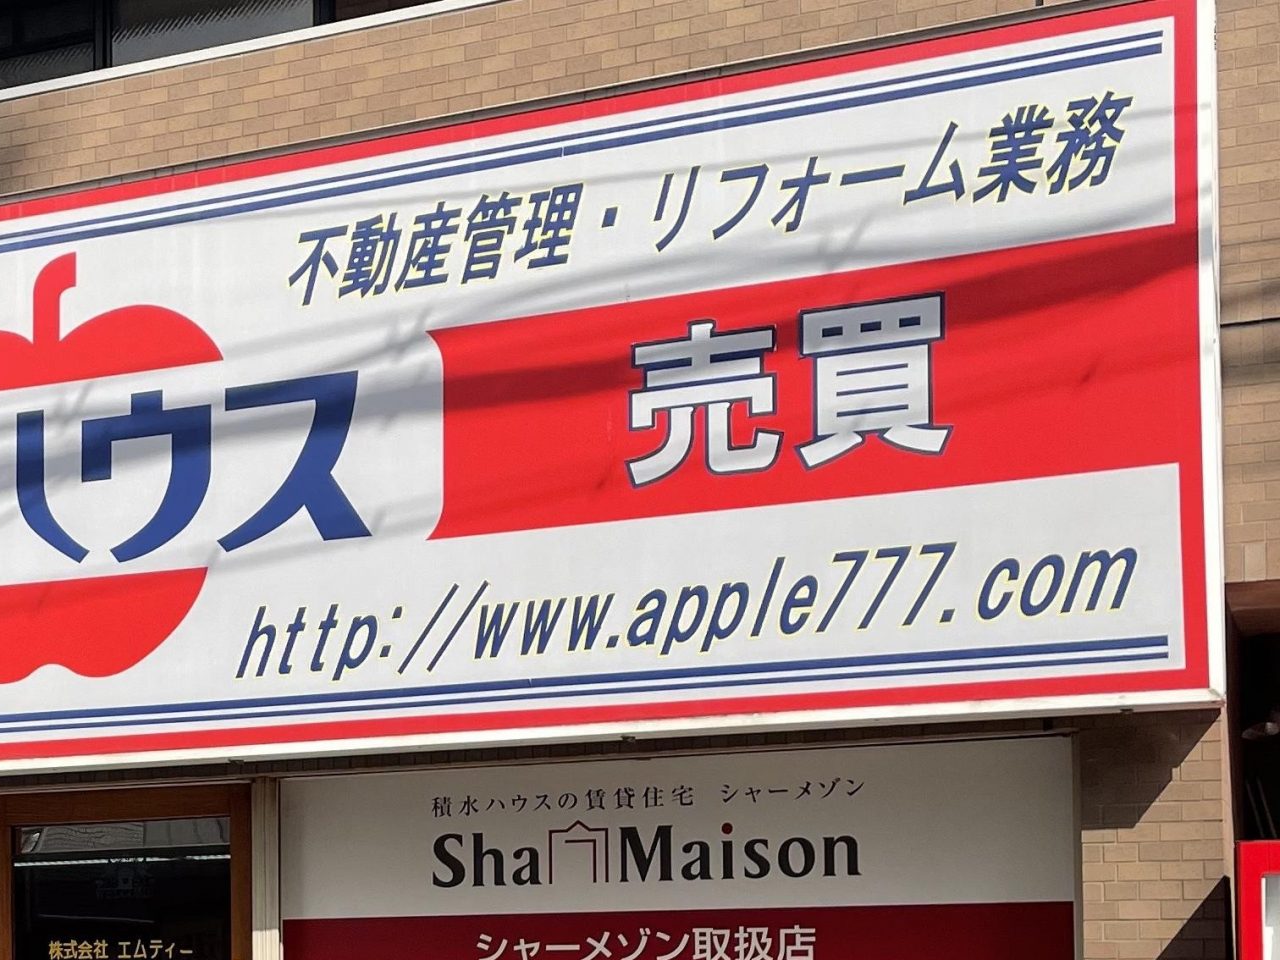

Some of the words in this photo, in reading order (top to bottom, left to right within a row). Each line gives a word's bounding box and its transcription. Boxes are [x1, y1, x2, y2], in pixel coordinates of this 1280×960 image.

[289, 90, 1132, 308] 不動産管理・リフォーム業務
[627, 291, 956, 488] 売買
[235, 542, 1139, 684] http://www.apple777.com
[431, 785, 695, 818] 積水ハウスの賃貸住宅
[720, 777, 866, 804] シャーメゾン
[48, 939, 109, 960] 株式会社
[117, 938, 193, 960] エムティー
